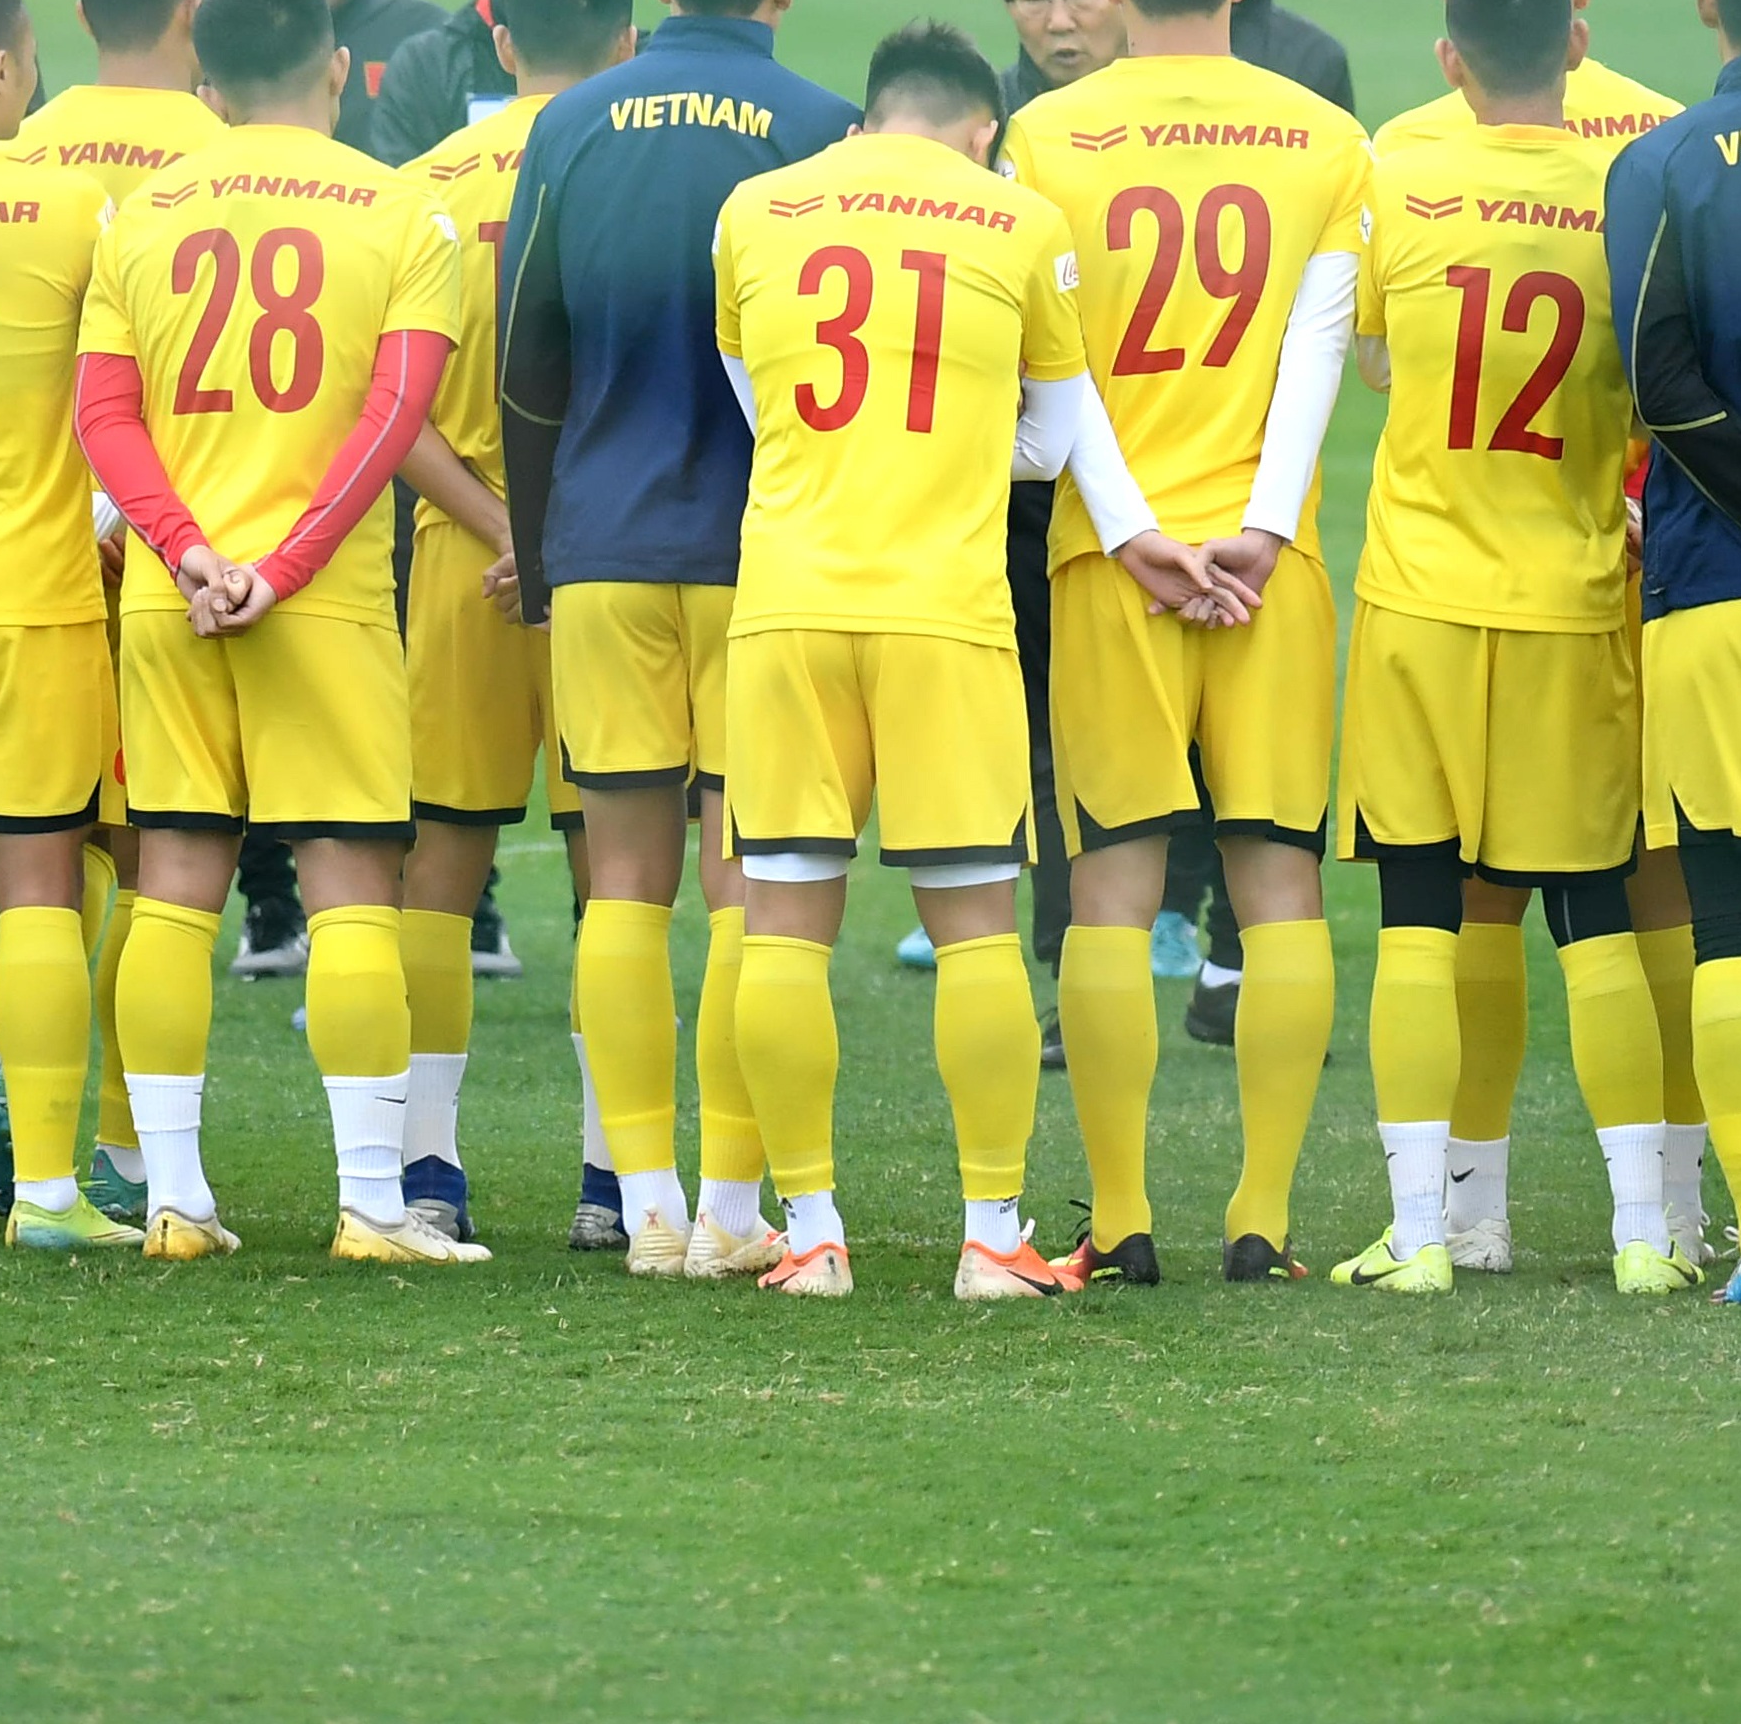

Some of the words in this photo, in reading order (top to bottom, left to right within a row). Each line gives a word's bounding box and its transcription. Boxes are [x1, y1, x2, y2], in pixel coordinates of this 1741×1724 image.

[611, 92, 773, 138] VIETNAM
[1140, 123, 1310, 150] YANMAR
[210, 174, 378, 207] YANMAR
[838, 192, 1017, 233] YANMAR
[173, 227, 325, 415] 28
[1106, 184, 1272, 377] 29
[795, 245, 947, 434] 31
[1446, 265, 1585, 459] 12
